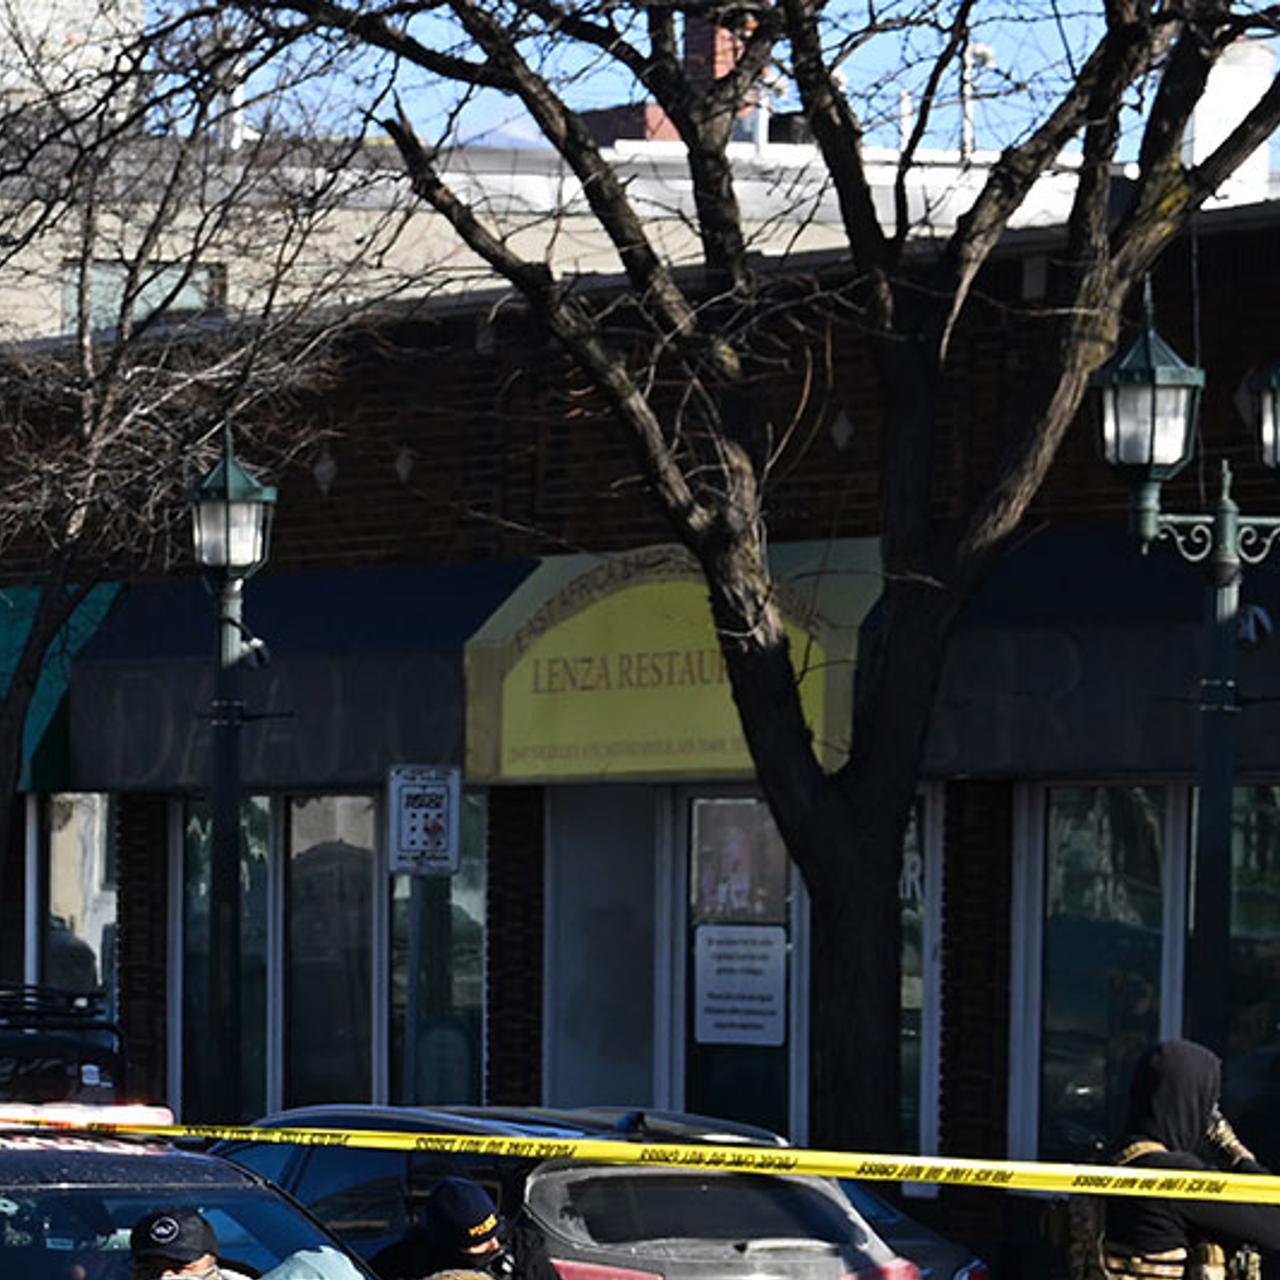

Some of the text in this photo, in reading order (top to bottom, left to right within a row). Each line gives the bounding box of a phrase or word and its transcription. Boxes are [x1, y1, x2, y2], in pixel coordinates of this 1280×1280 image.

[532, 653, 611, 695] LENZA
[856, 1161, 897, 1177] CROSS
[1071, 1173, 1113, 1189] CROSS
[1186, 1179, 1229, 1195] POLICE
